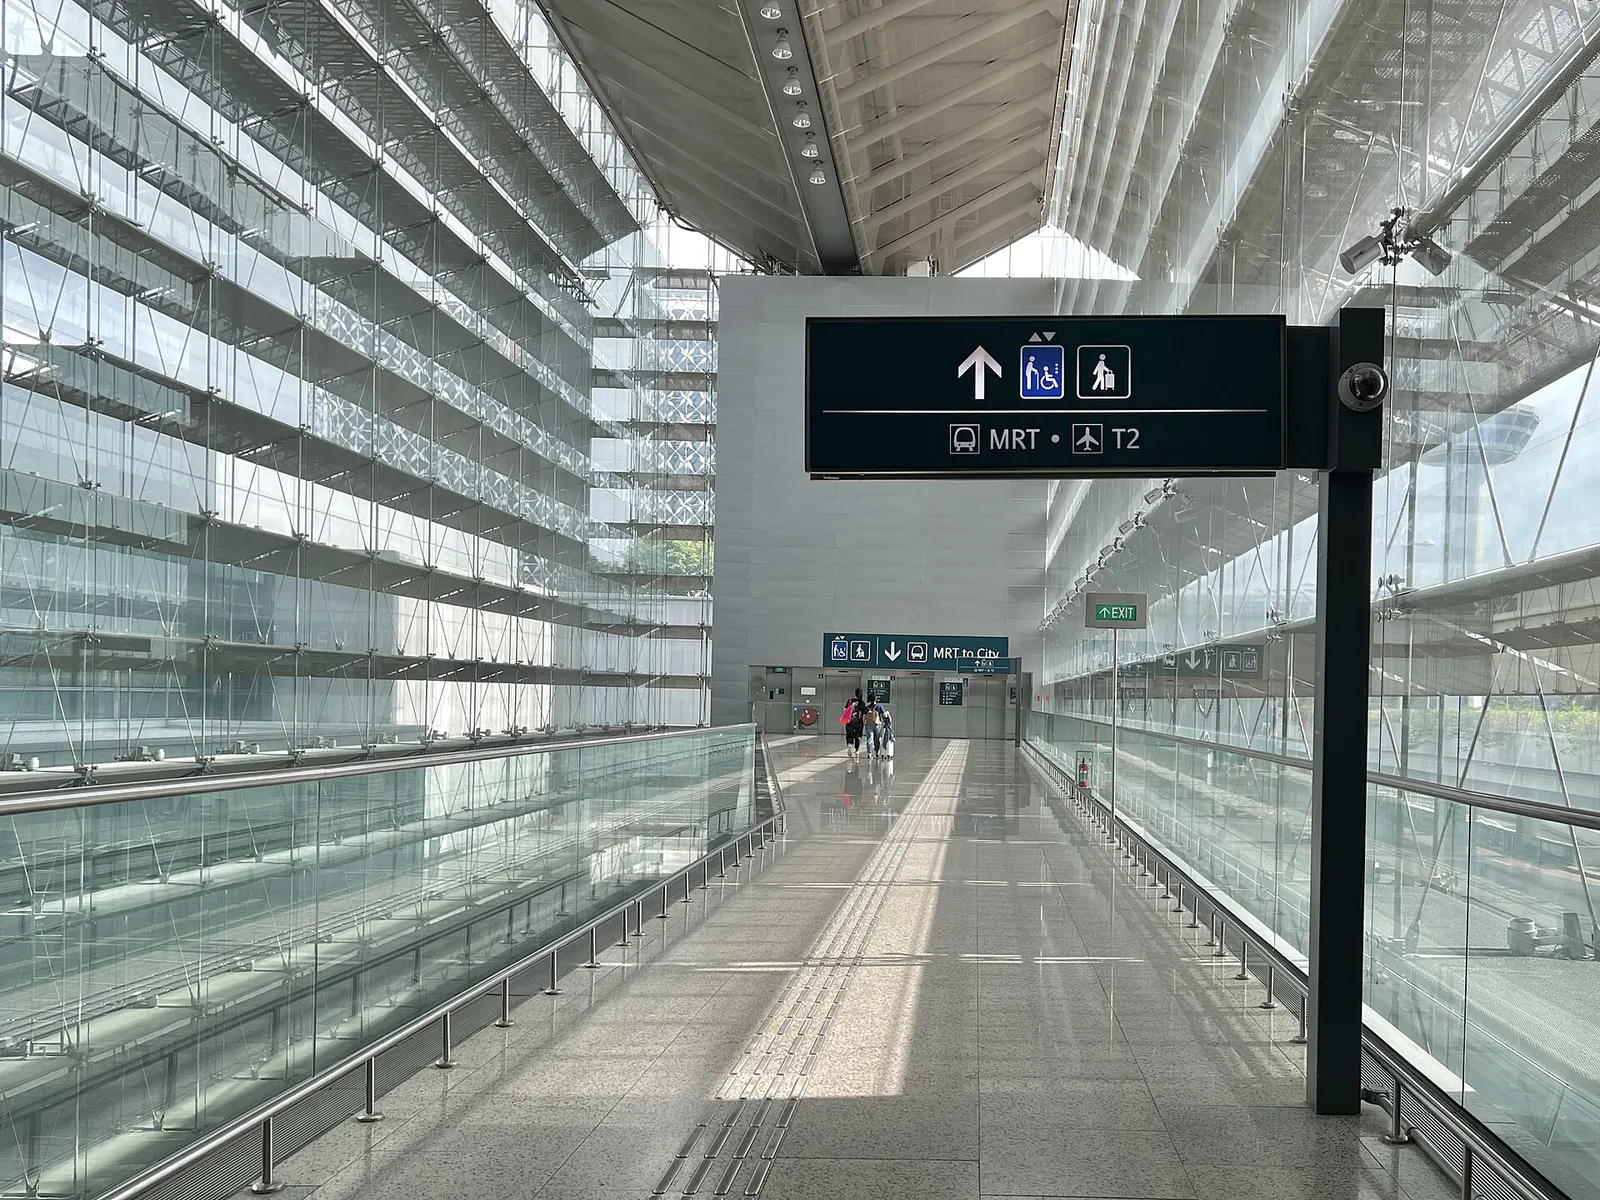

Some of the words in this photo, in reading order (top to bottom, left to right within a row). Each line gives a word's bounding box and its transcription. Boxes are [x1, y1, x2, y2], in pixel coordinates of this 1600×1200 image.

[990, 428, 1040, 450] MRT
[1111, 427, 1140, 449] T2
[1111, 606, 1134, 619] EXIT
[933, 647, 960, 659] MRT
[962, 648, 974, 658] to
[977, 648, 1000, 658] City
